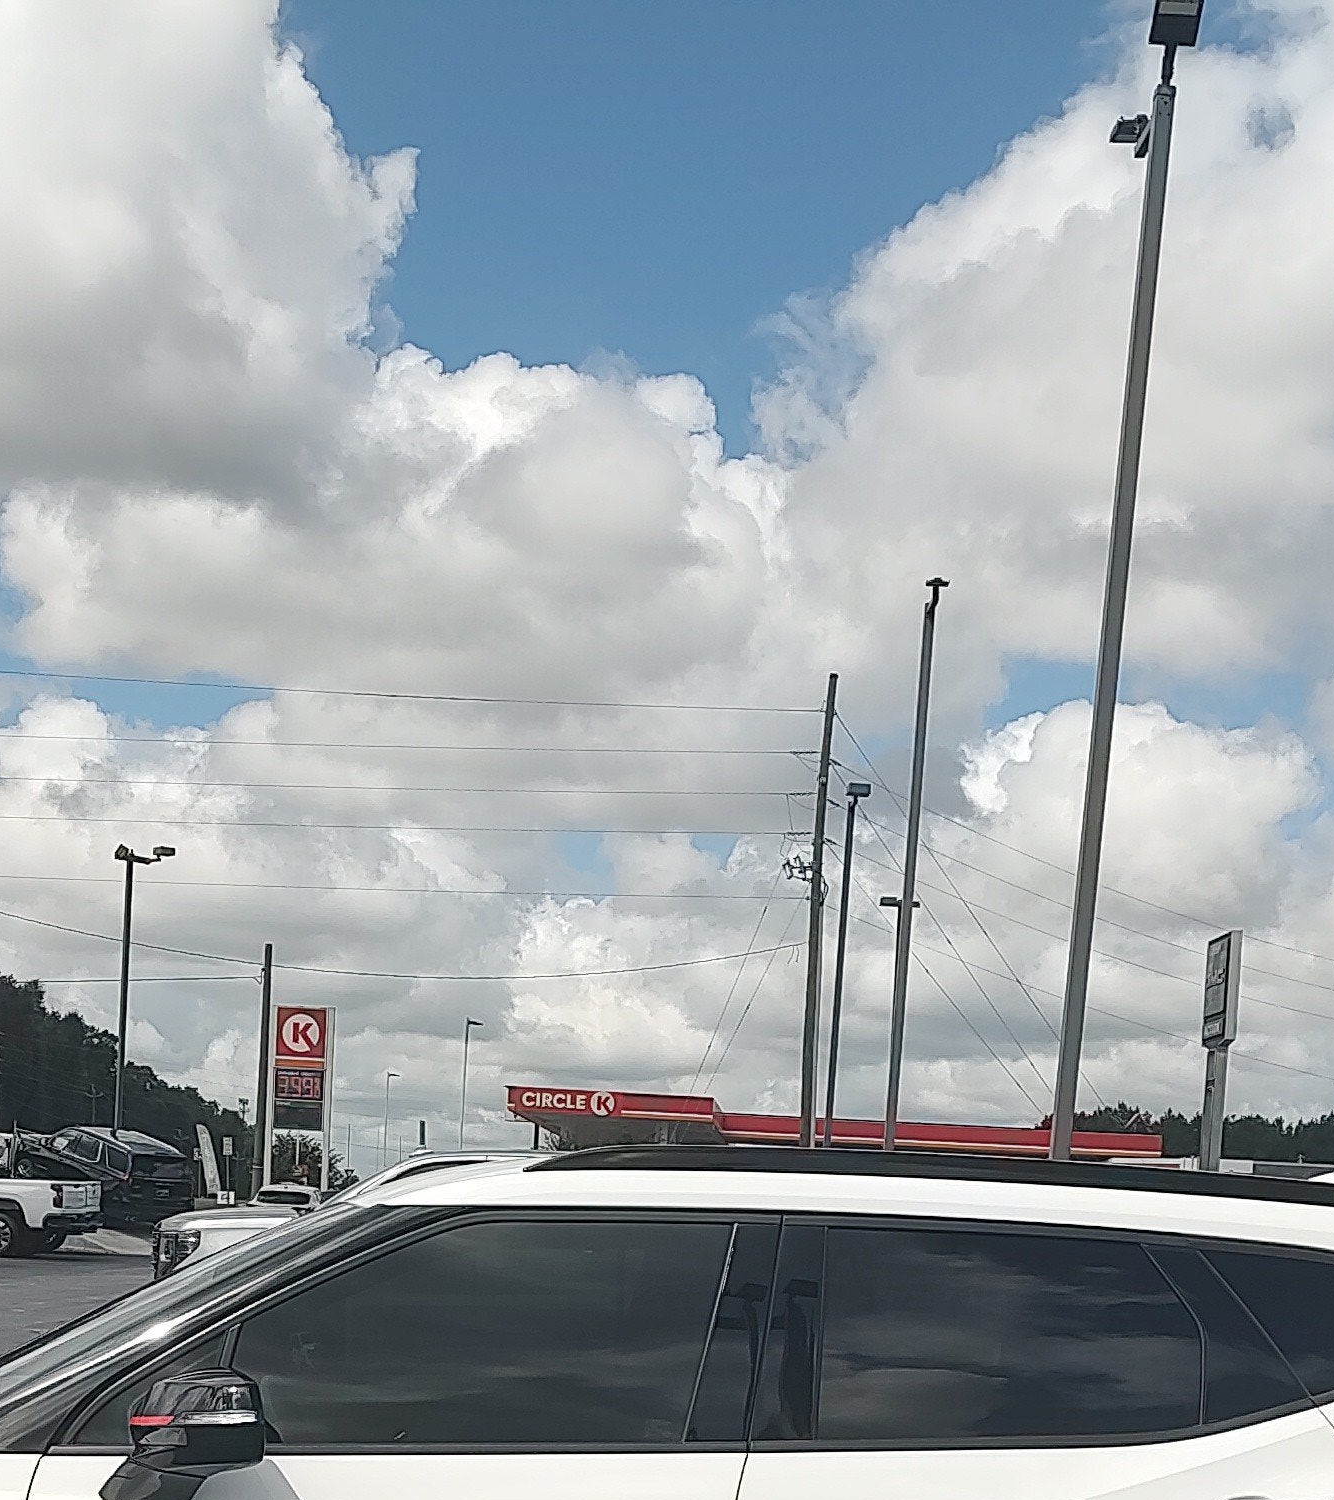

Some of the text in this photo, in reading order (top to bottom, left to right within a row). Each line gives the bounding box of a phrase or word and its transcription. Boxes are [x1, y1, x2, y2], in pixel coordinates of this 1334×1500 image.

[291, 1020, 318, 1052] K
[521, 1091, 613, 1115] CIRCLE K
